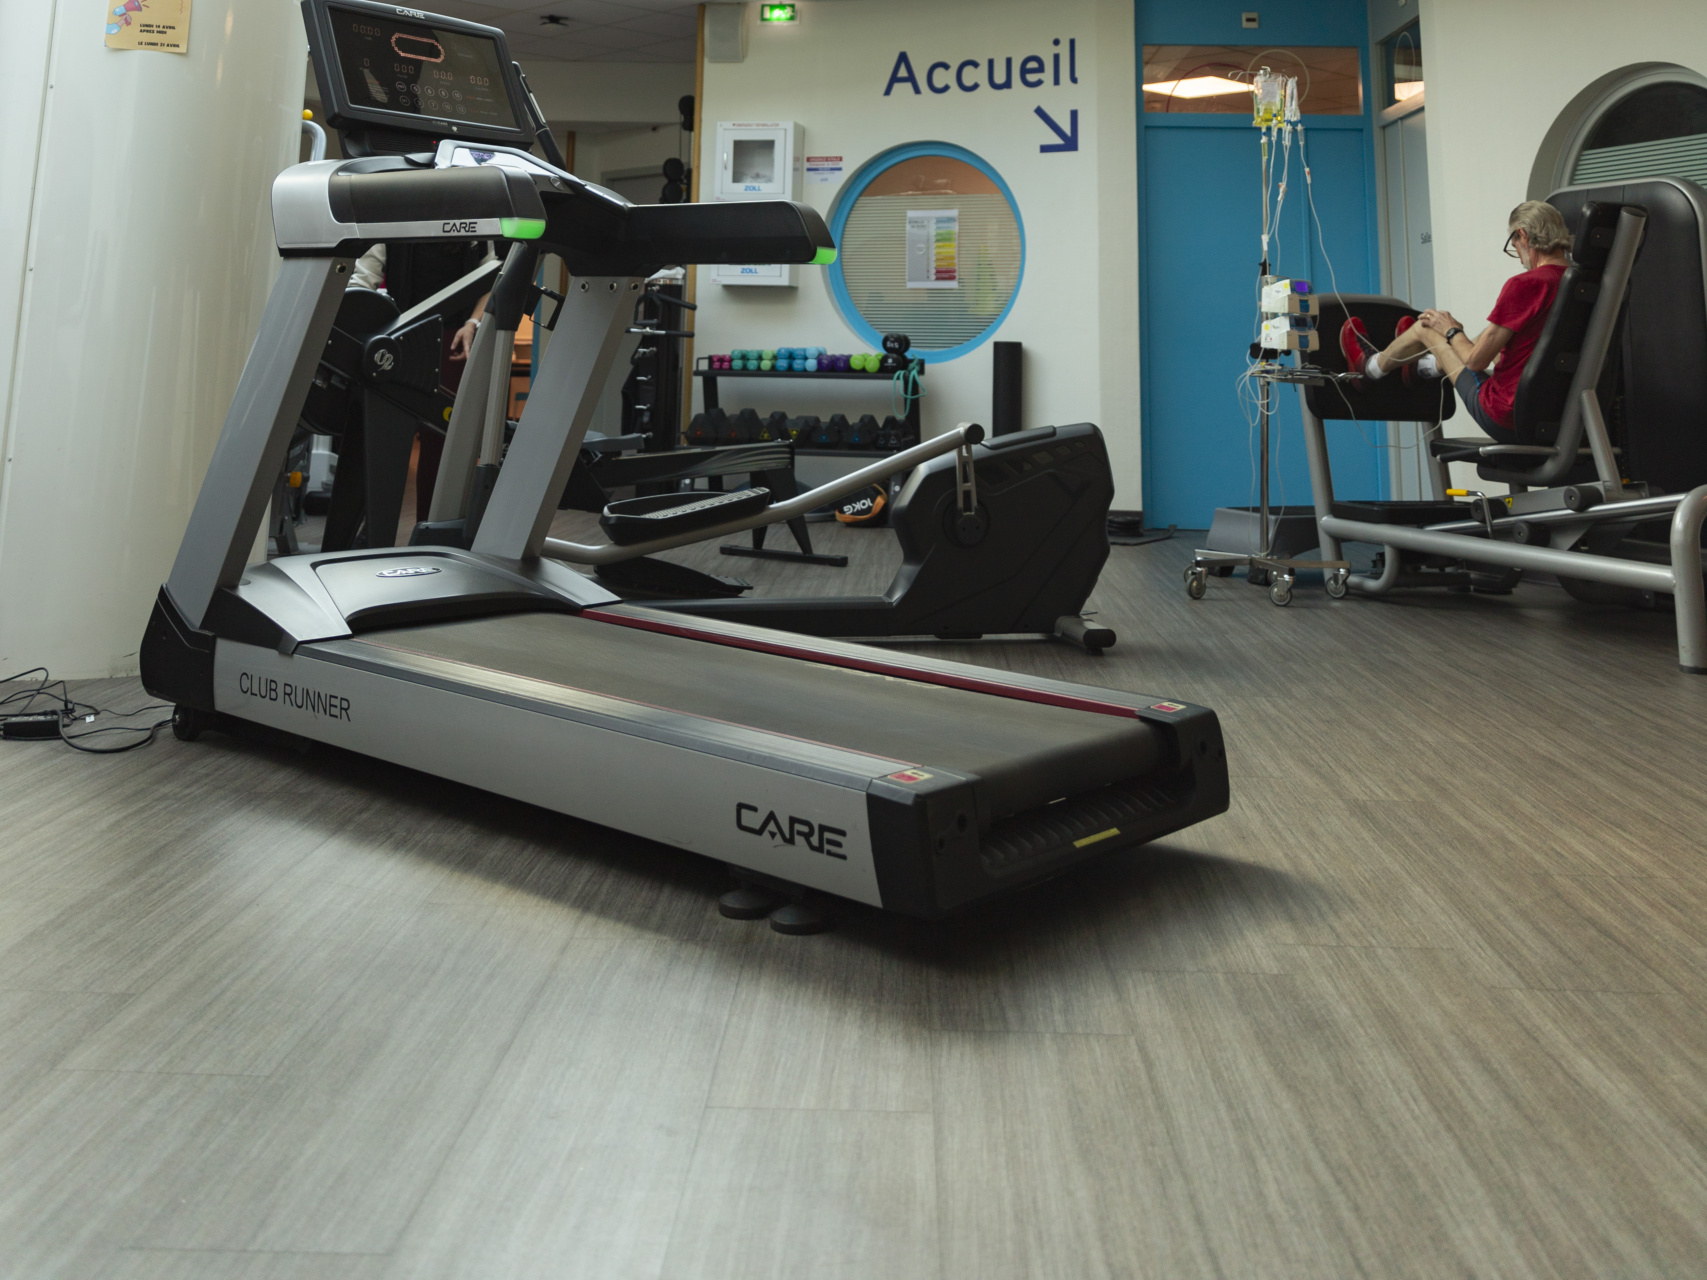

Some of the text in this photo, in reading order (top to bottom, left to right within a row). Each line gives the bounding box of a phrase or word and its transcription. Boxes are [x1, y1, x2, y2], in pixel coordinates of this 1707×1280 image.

[395, 7, 425, 19] CARE
[883, 38, 1079, 97] Accueil
[442, 221, 478, 234] CARE
[843, 497, 873, 515] 10KG
[240, 672, 351, 722] CLUB RUNNER
[736, 802, 847, 861] CARE
